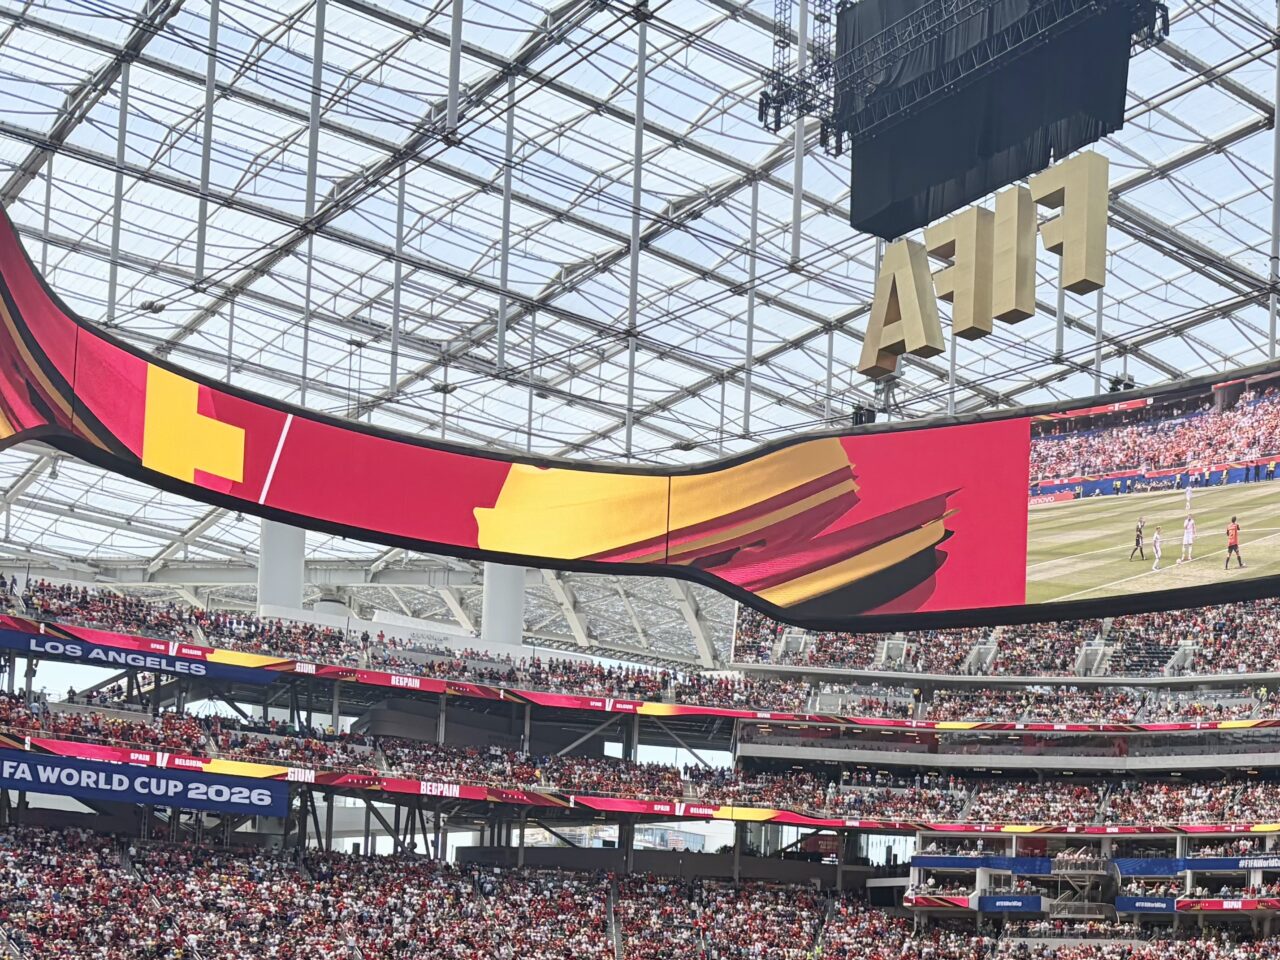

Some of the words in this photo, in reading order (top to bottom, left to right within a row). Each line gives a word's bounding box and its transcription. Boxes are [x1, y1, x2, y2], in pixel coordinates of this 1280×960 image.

[30, 639, 82, 657] LOS
[88, 648, 206, 676] ANGELES
[156, 752, 169, 769] V
[37, 764, 129, 791] WORLD
[134, 775, 184, 797] CUP
[187, 782, 272, 805] 2026
